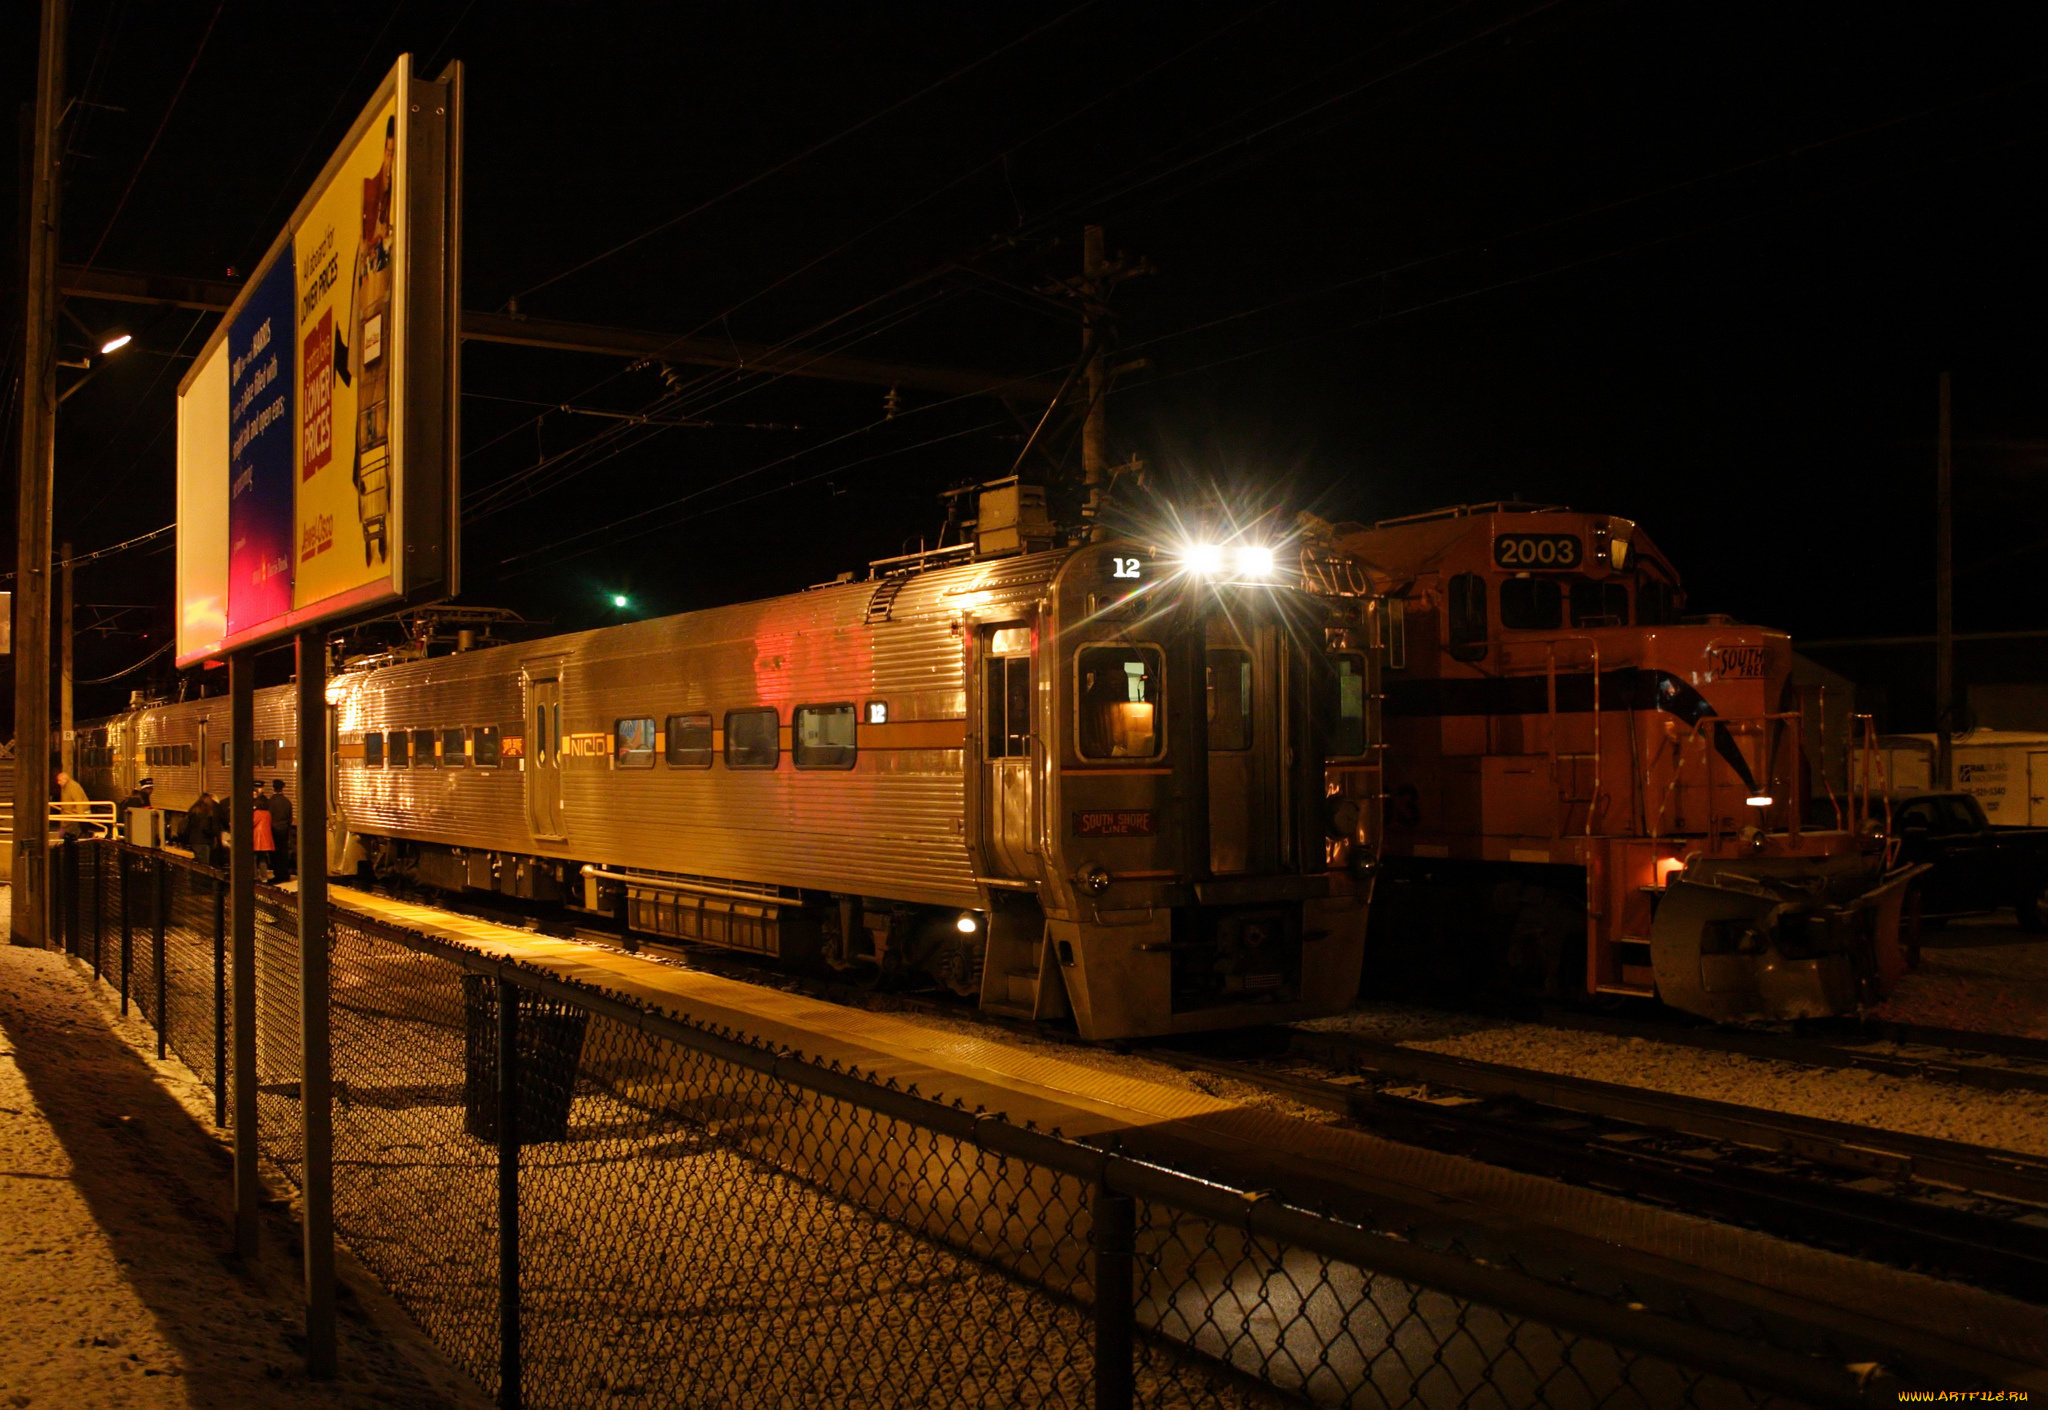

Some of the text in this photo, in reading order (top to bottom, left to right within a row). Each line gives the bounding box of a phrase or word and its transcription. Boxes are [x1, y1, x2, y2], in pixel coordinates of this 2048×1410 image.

[301, 251, 339, 327] LOWER PRICES
[304, 364, 331, 424] LOWER
[304, 405, 331, 467] PRICES
[1501, 539, 1575, 564] 2003
[1113, 557, 1141, 578] 12
[1721, 648, 1765, 675] SOUTH
[870, 703, 886, 723] 12
[1082, 812, 1150, 832] SOUTH SHORE
[1102, 825, 1129, 834] LINE
